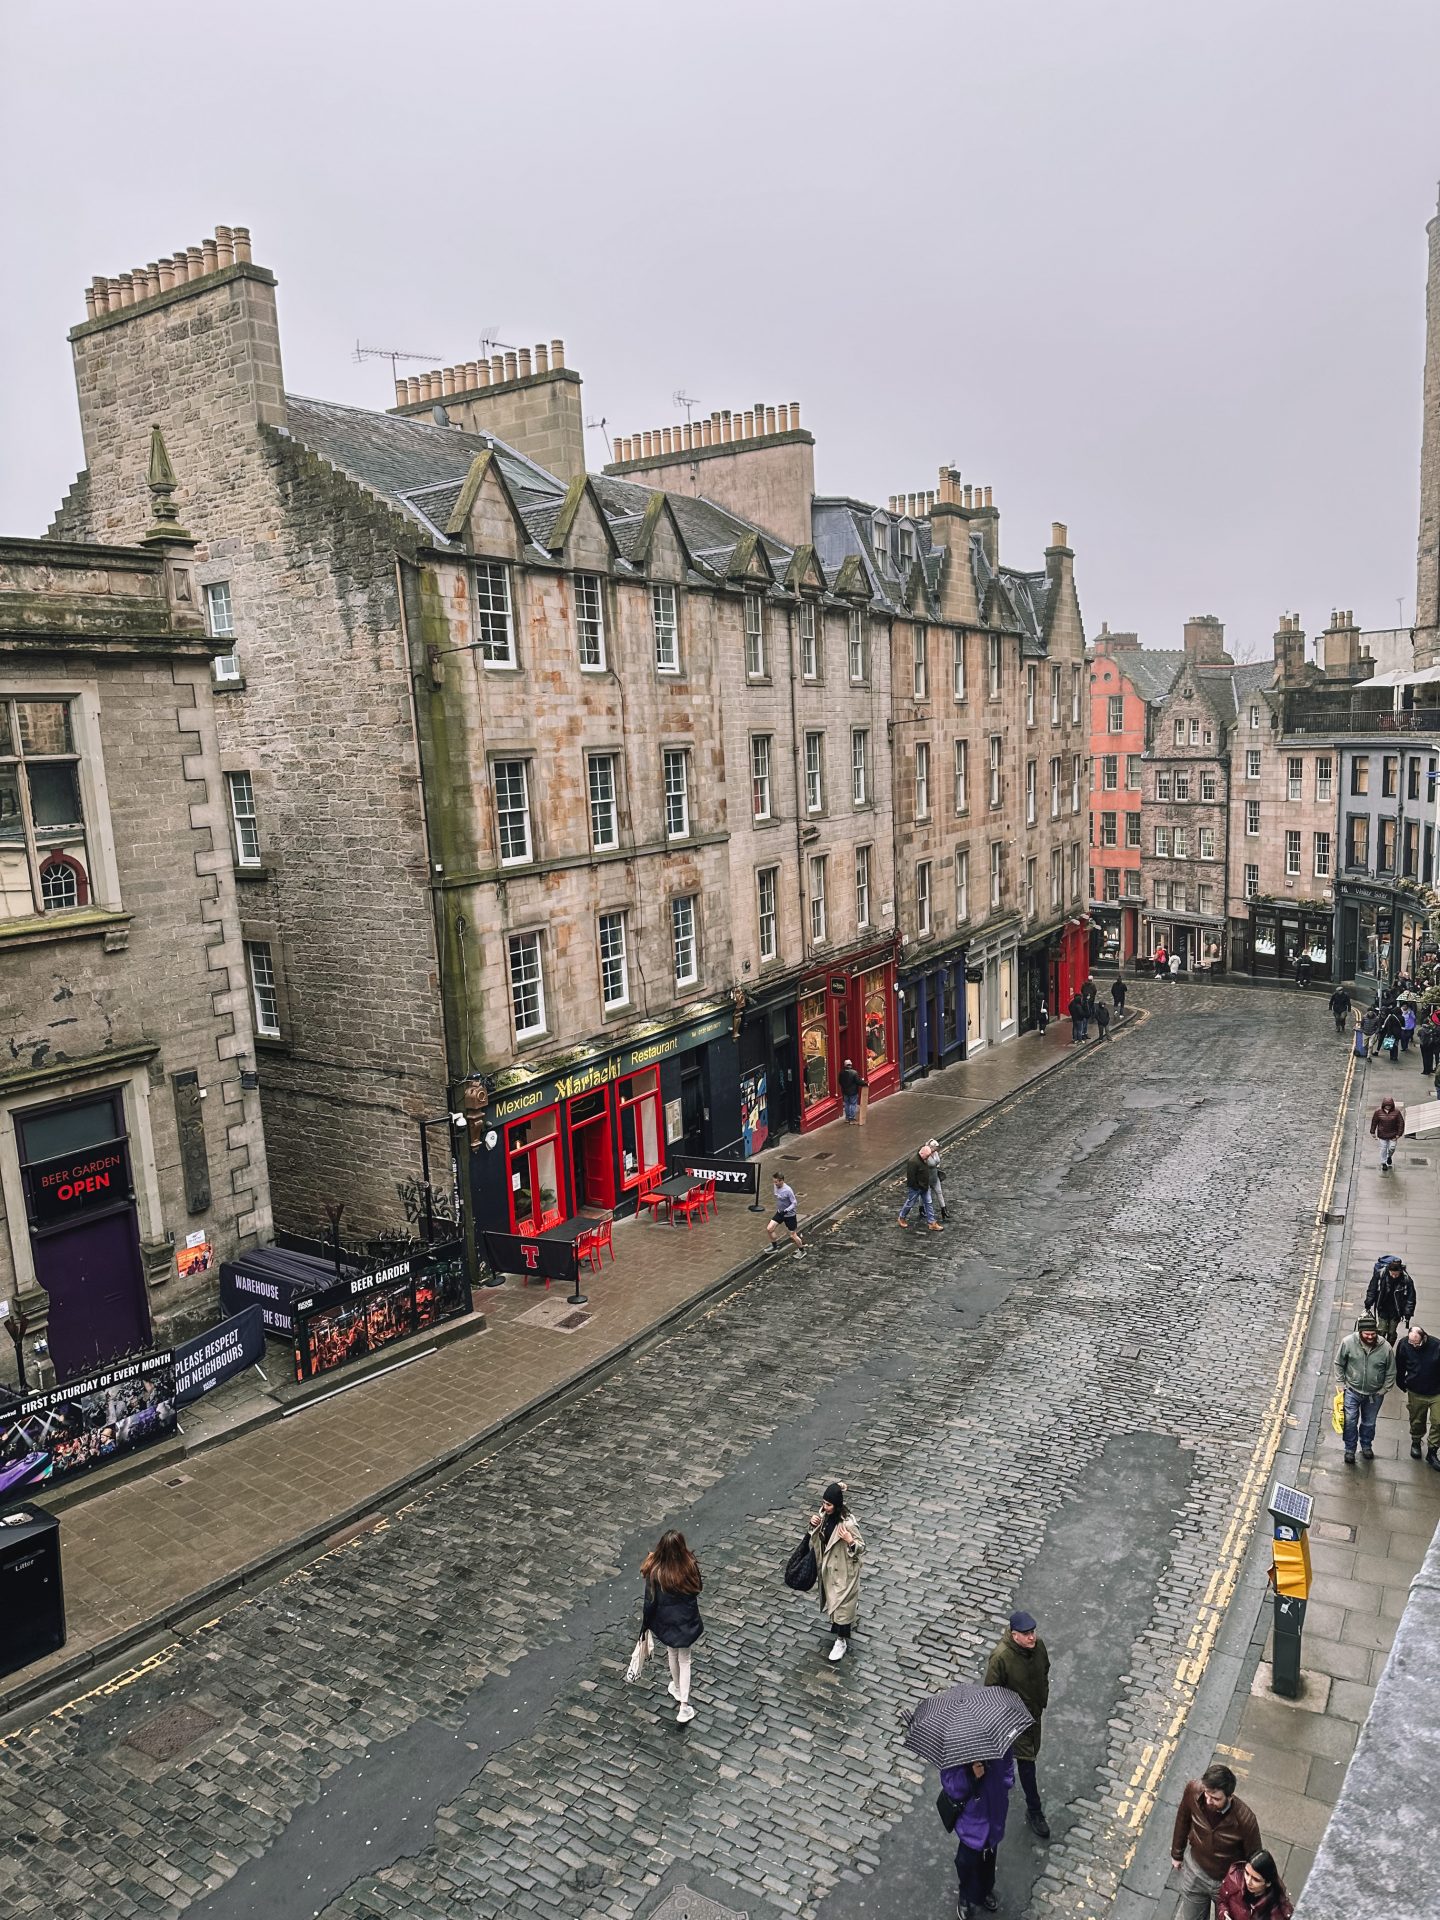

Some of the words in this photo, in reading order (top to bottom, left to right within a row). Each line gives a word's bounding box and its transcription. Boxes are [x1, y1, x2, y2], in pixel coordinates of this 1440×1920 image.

[496, 1091, 543, 1118] Mexican
[554, 1056, 622, 1103] Mariachi
[631, 1037, 678, 1065] Restaurant
[41, 1170, 70, 1187] BEER
[72, 1155, 120, 1177] GARDEN
[57, 1172, 110, 1200] OPEN
[685, 1167, 747, 1183] THIRSTY?
[521, 1245, 539, 1268] T
[235, 1274, 279, 1300] WAREHOUSE
[351, 1275, 373, 1294] BEER
[376, 1262, 410, 1284] GARDEN
[175, 1349, 204, 1377] PLEASE
[205, 1329, 239, 1359] RESPECT
[192, 1344, 244, 1384] NEIGHBOURS
[22, 1396, 48, 1414] FIRST
[50, 1379, 98, 1404] SATURDAY
[100, 1374, 111, 1386] OF
[114, 1364, 140, 1381] EVERY
[142, 1353, 171, 1371] MONTH
